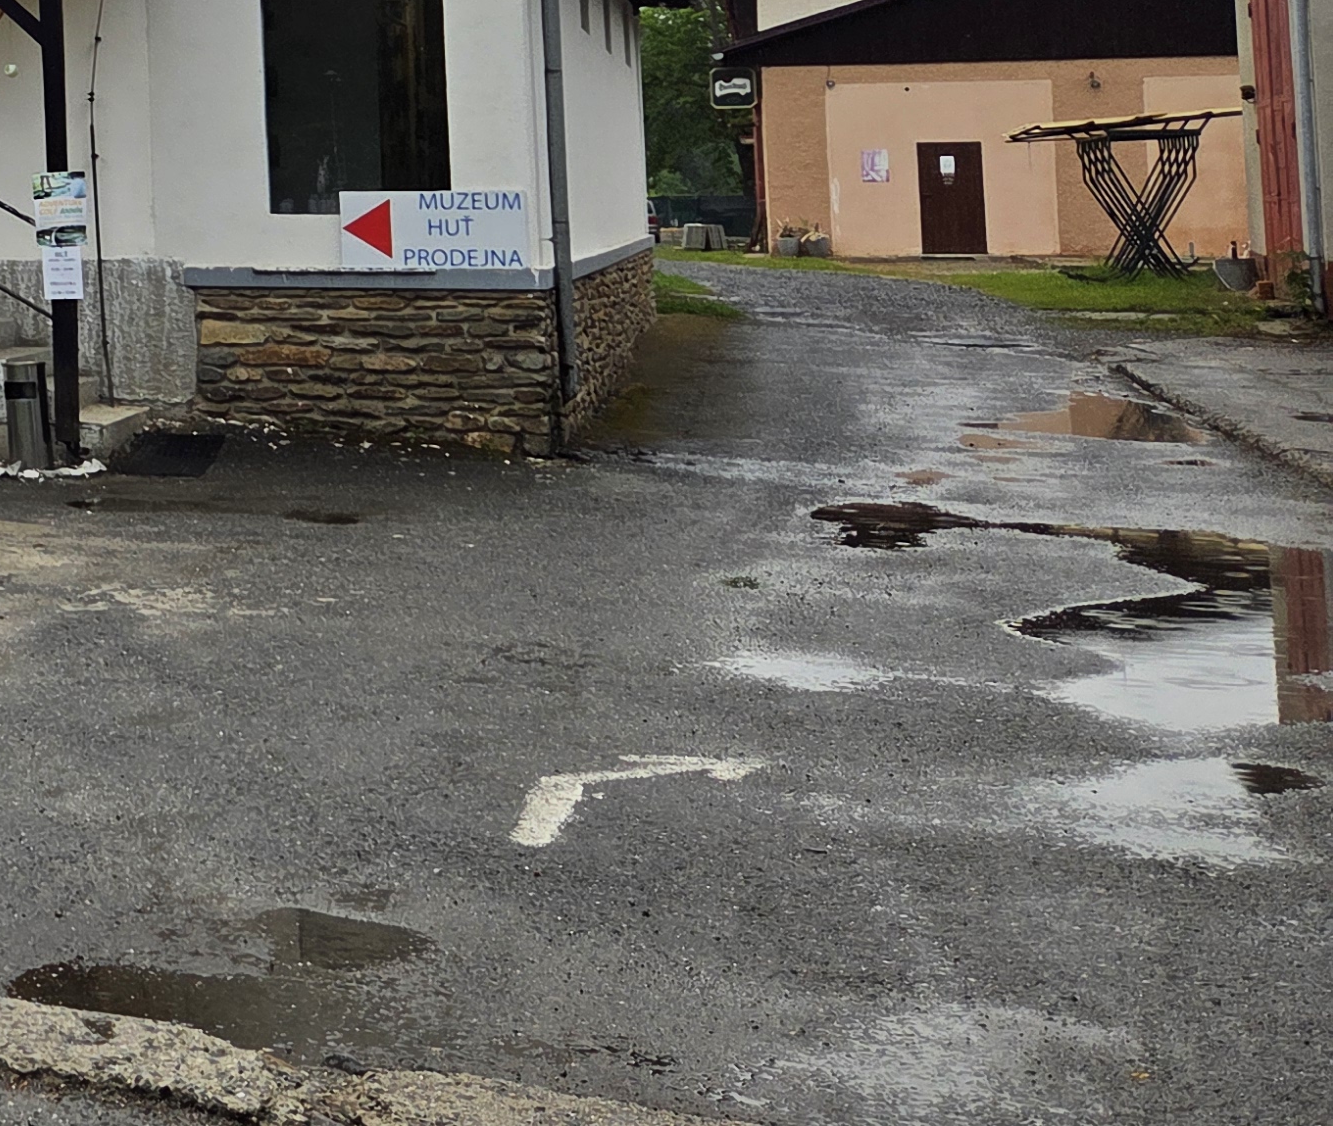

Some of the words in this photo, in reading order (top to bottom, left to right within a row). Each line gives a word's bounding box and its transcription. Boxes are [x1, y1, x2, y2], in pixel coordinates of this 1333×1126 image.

[418, 192, 522, 211] MUZEUM
[427, 215, 475, 237] HUŤ
[403, 248, 524, 267] PRODEJNA
